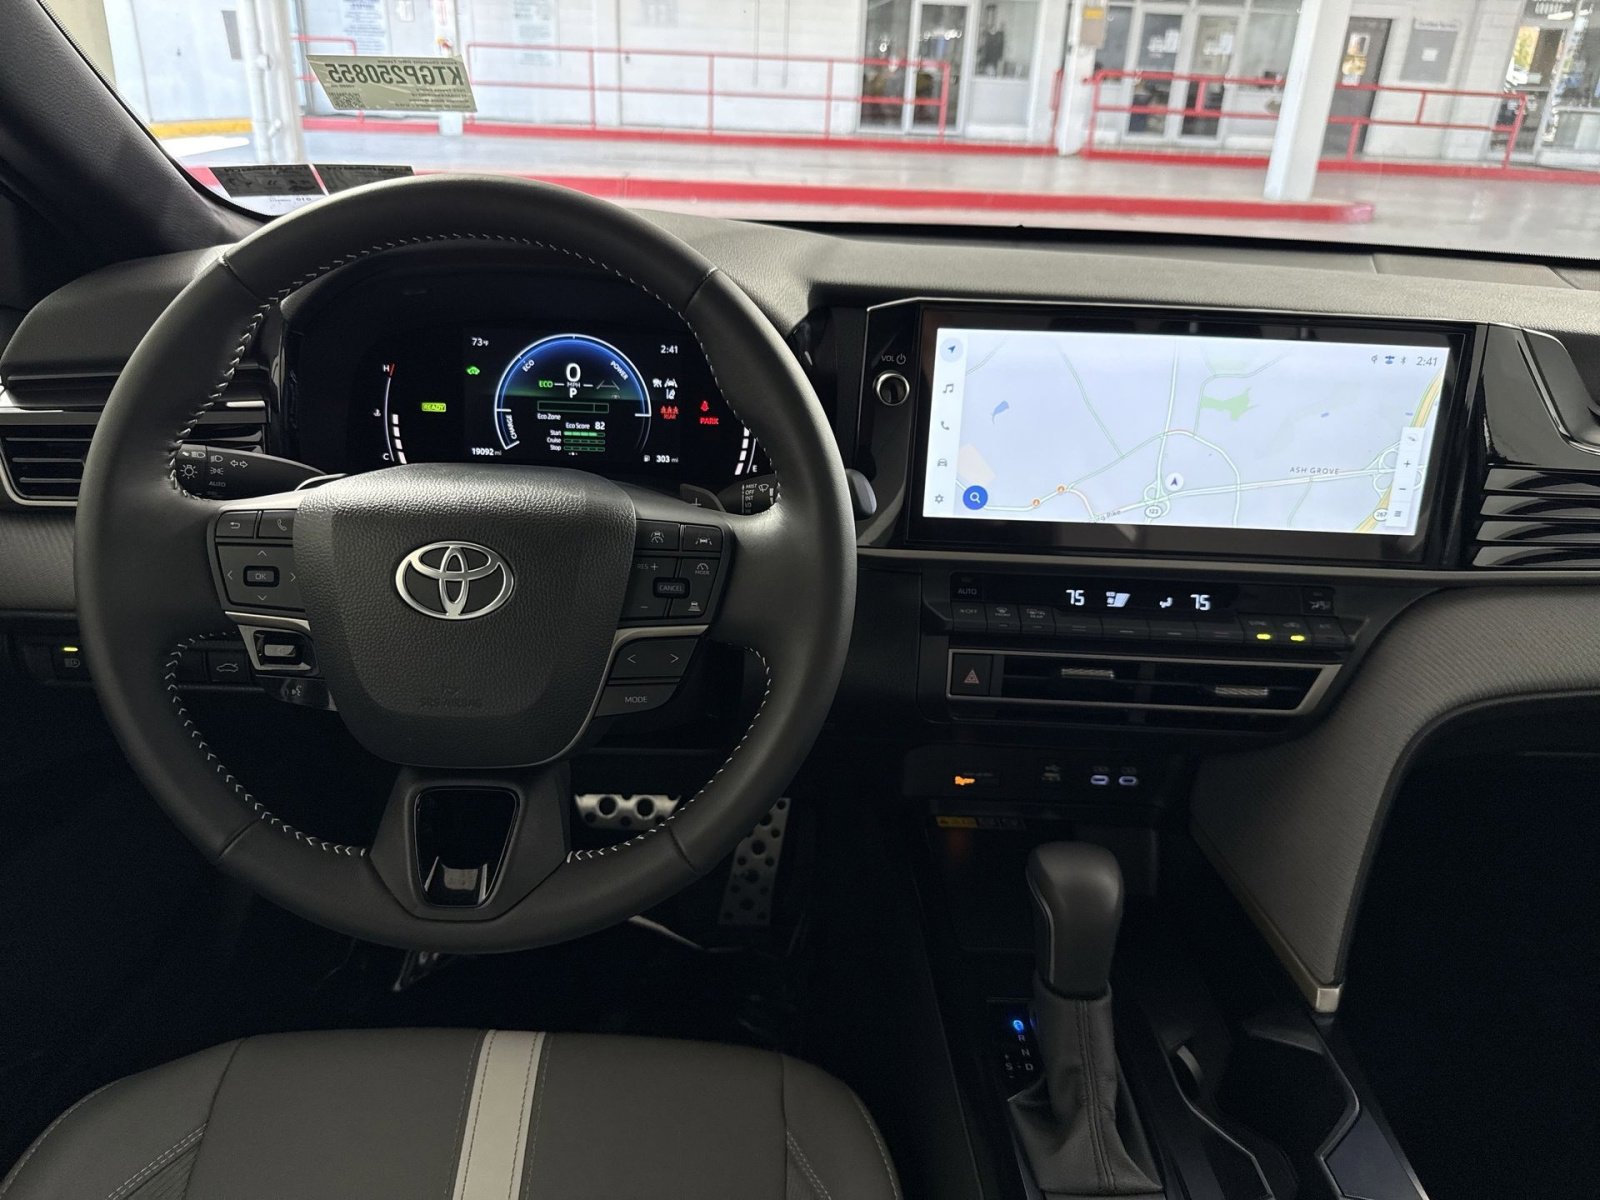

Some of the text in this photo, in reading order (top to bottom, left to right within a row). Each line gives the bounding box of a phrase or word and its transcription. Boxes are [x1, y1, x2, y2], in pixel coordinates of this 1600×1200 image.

[660, 345, 679, 354] 2:41
[522, 359, 535, 372] ECO
[1416, 356, 1438, 367] 2:41
[383, 364, 390, 373] H
[610, 360, 629, 381] POWER
[538, 380, 554, 388] ECO
[569, 388, 578, 398] P
[423, 403, 446, 411] READY
[699, 417, 720, 425] PARK
[505, 414, 518, 440] CHARGE
[565, 422, 606, 431] Eco Score 82
[471, 447, 494, 456] 19092
[382, 453, 390, 461] C
[656, 455, 670, 463] 303
[752, 464, 758, 472] E
[1290, 466, 1340, 476] ASH GROVE
[658, 584, 683, 592] CANCEL
[958, 587, 977, 595] AUTO
[1065, 589, 1085, 606] 75
[1190, 593, 1211, 611] 75
